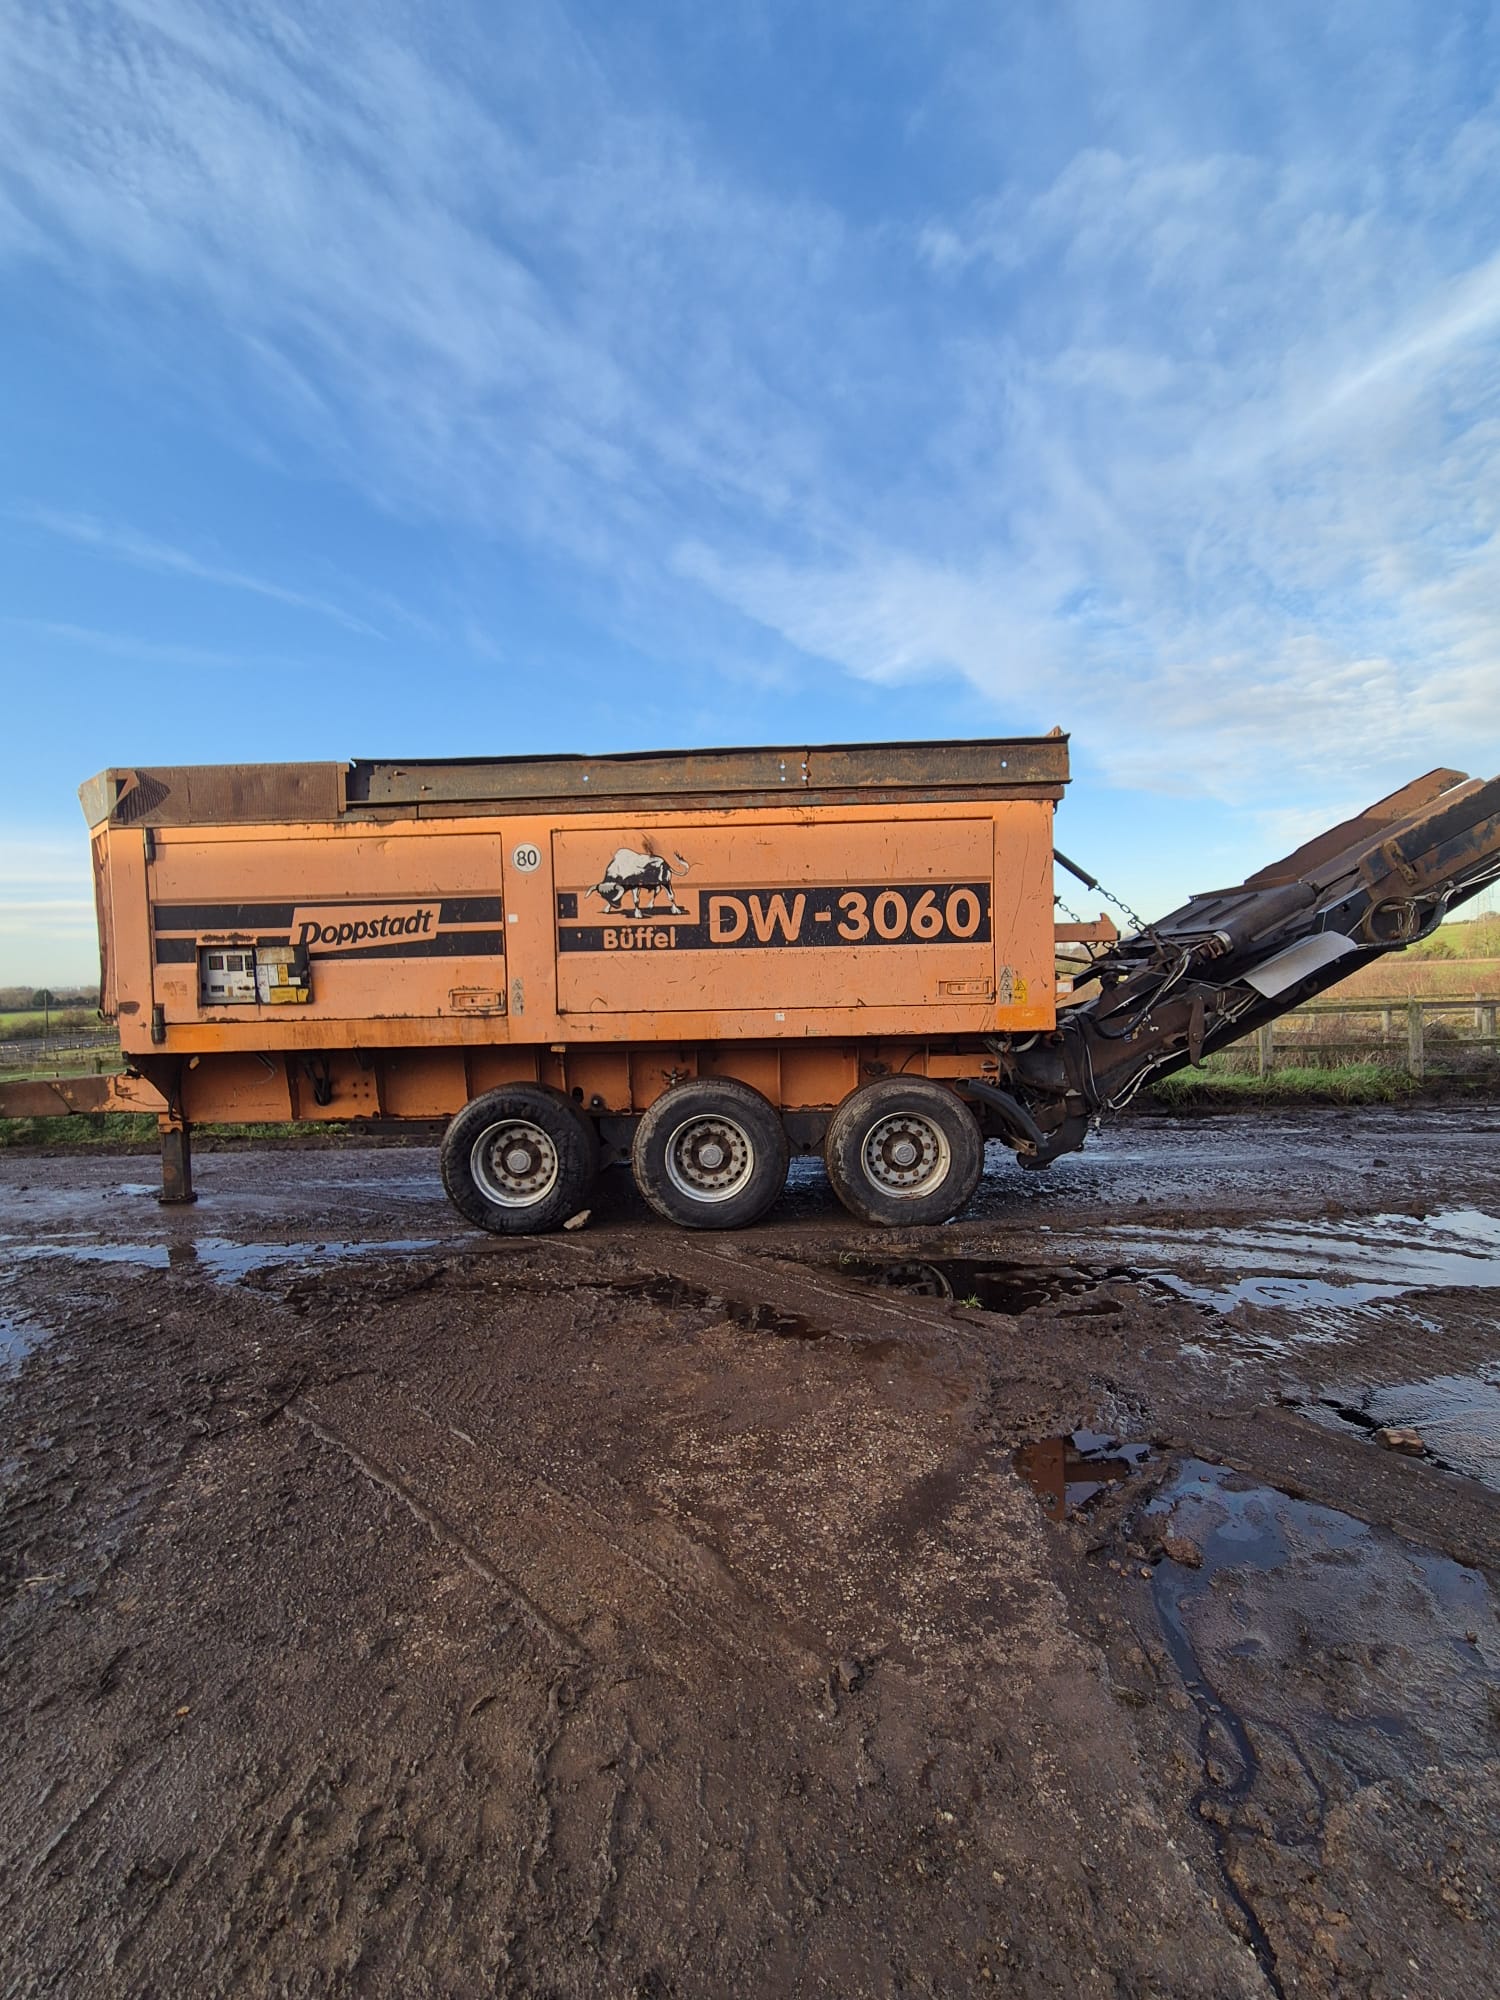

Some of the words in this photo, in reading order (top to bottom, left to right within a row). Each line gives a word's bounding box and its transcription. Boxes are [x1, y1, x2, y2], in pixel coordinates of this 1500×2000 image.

[516, 849, 537, 867] 80
[298, 909, 433, 945] Doppstadt
[708, 888, 980, 943] DW-3060
[603, 926, 676, 949] Büffel
